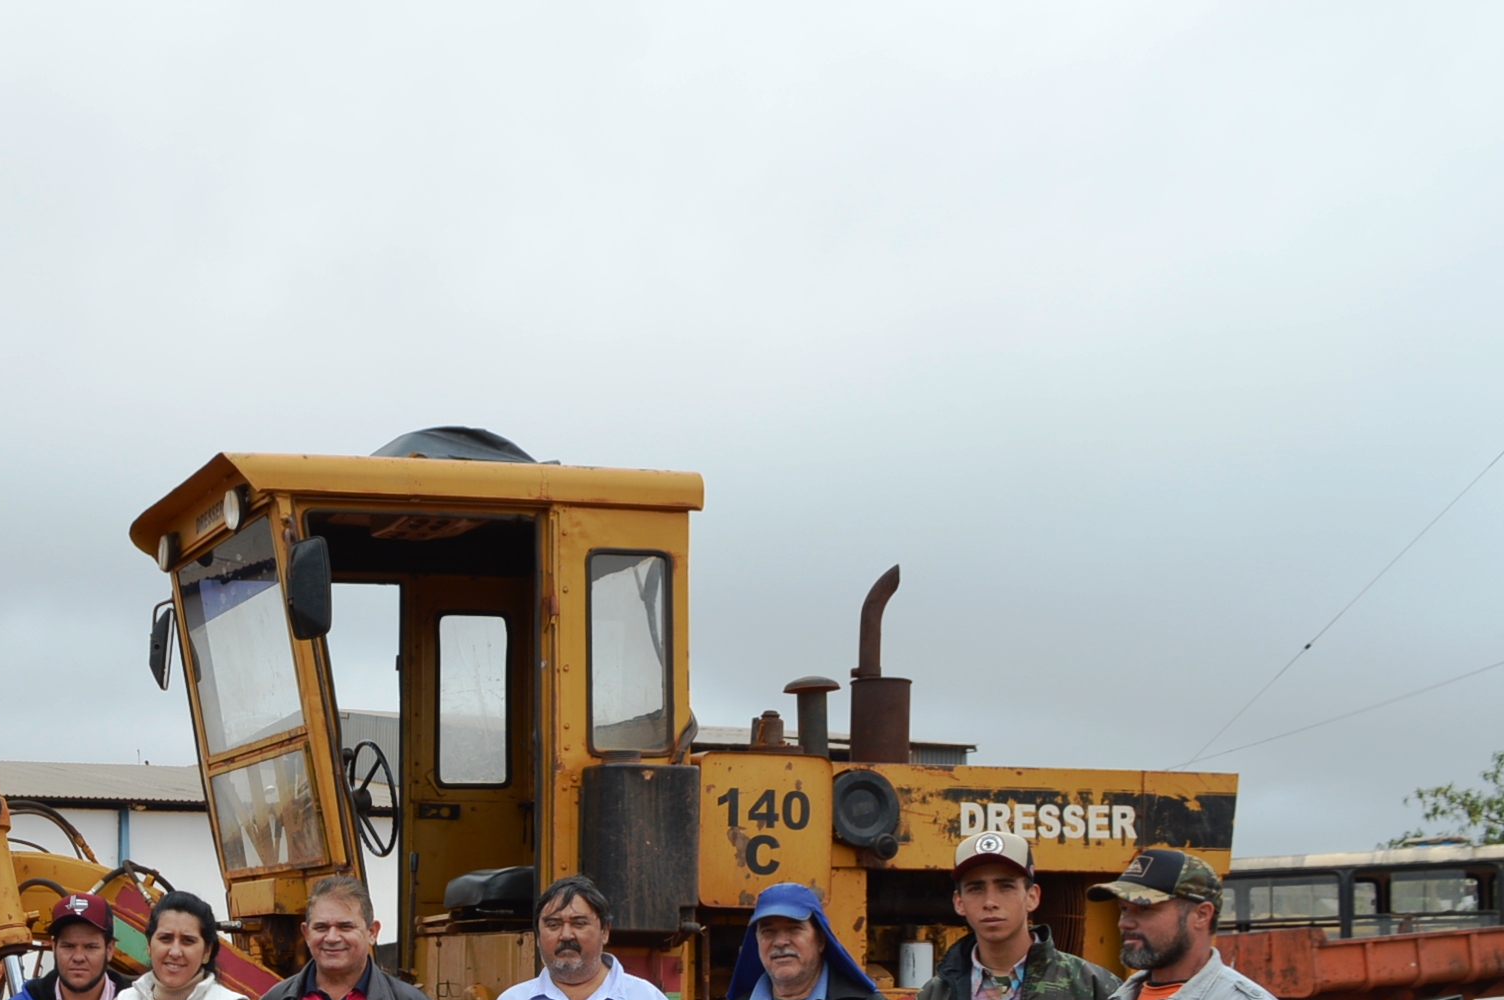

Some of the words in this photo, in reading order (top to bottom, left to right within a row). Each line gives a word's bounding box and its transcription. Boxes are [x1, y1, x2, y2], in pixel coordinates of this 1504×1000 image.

[717, 788, 811, 831] 140
[960, 802, 1138, 839] DRESSER
[746, 834, 780, 876] C
